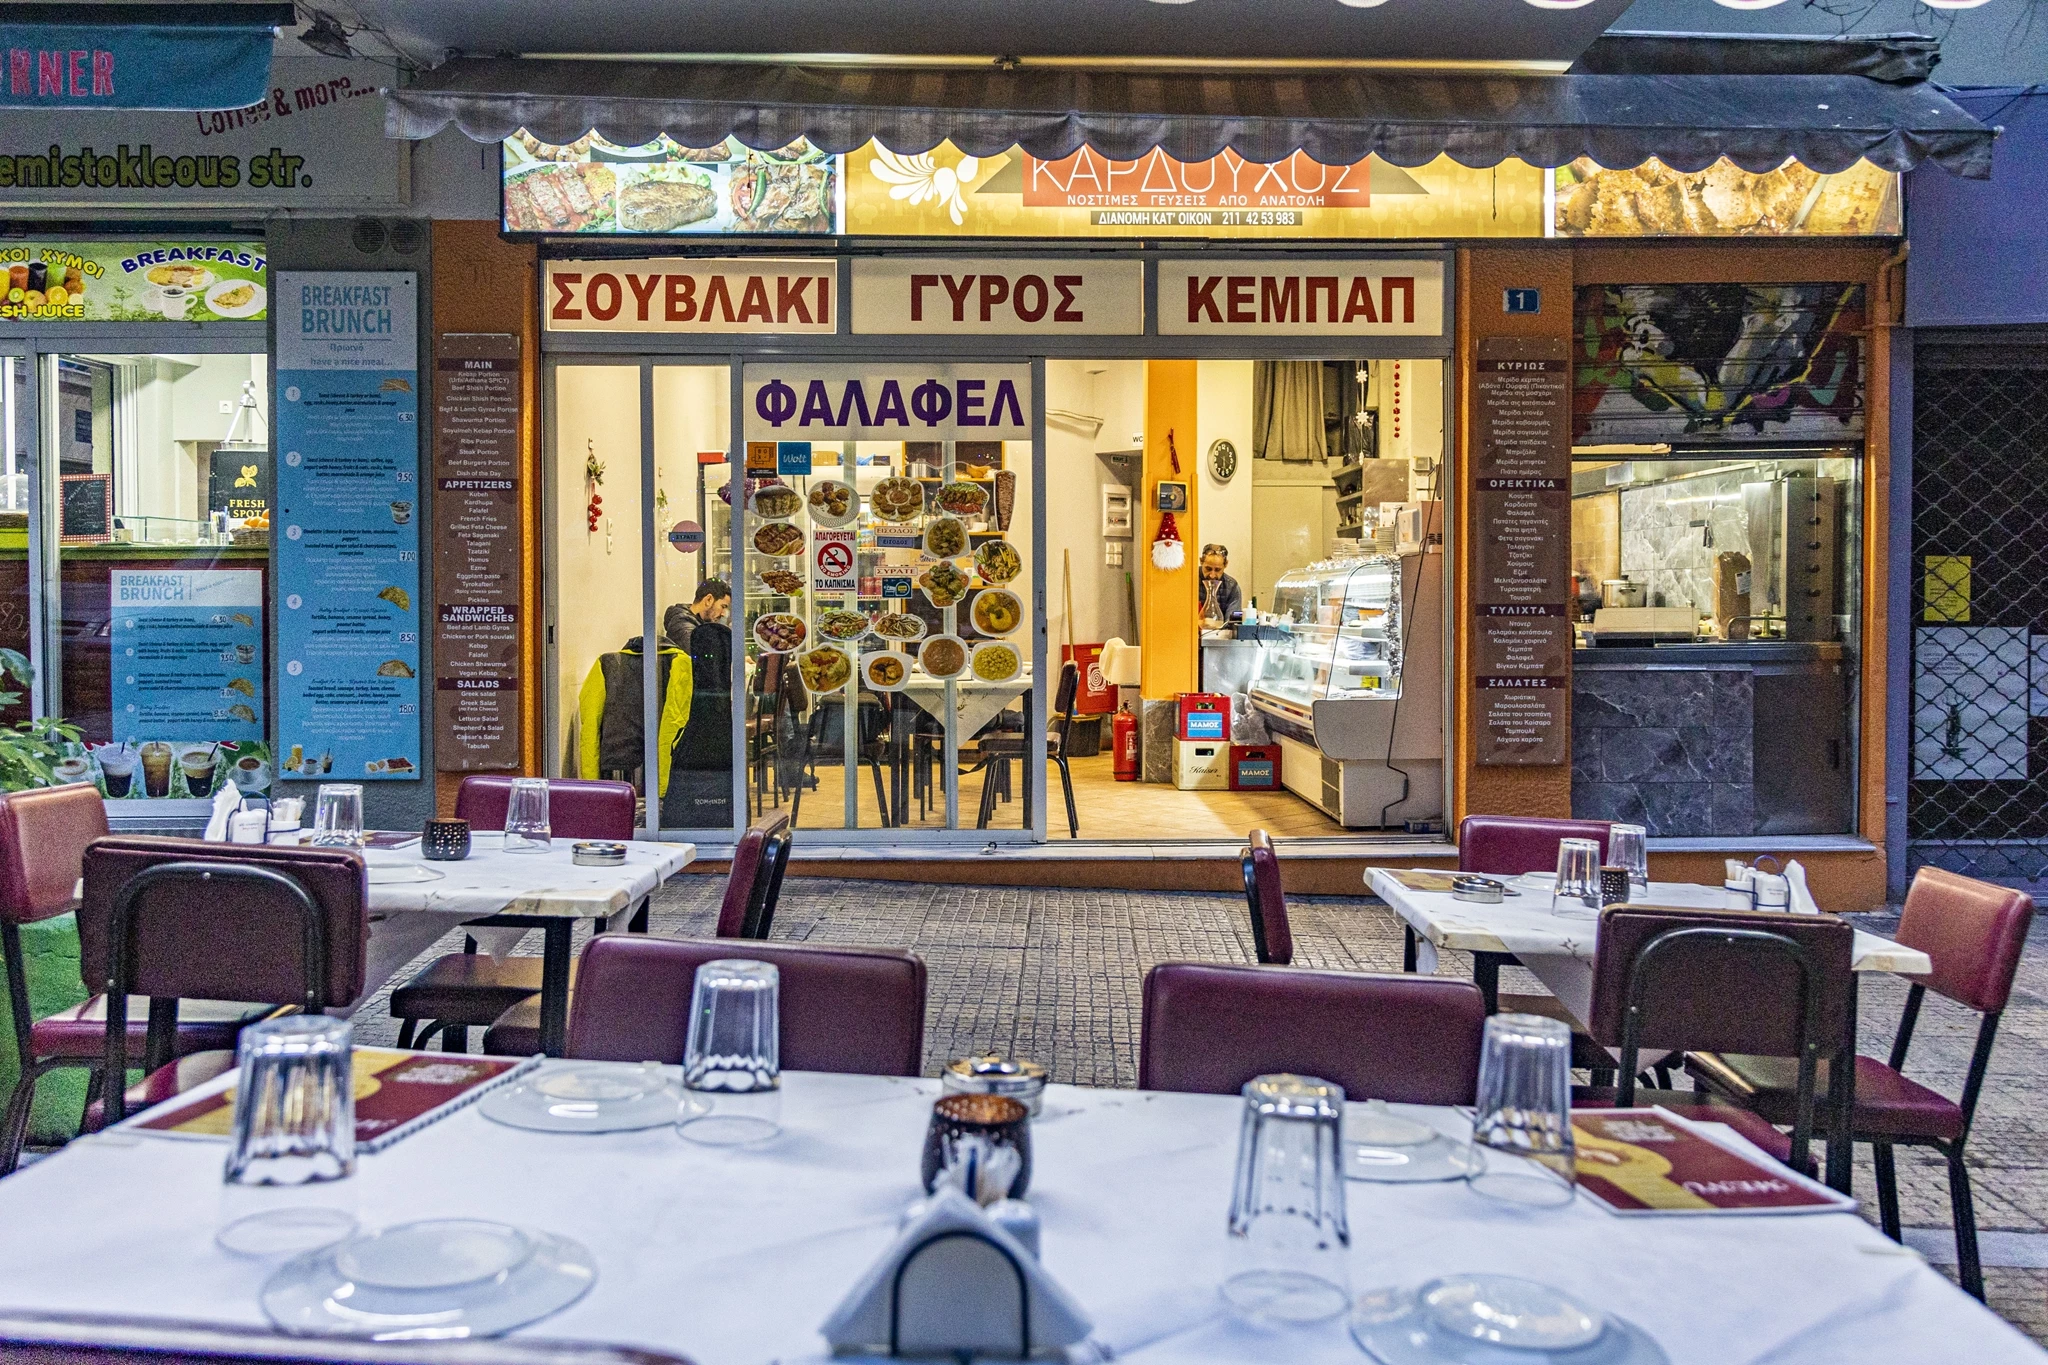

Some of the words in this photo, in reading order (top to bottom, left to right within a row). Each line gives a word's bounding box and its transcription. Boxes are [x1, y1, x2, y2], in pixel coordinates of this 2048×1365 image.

[0, 48, 115, 97] RNER
[272, 87, 292, 116] &
[248, 147, 313, 188] str.
[1067, 194, 1138, 206] ΝΟΣΤΙΜΕΣ
[1150, 194, 1208, 206] ΓΕΥΣΕΙΣ
[1218, 195, 1248, 206] ΑΠΟ
[1259, 195, 1325, 206] ΑΝΑΤΟΛΗ
[1098, 211, 1150, 225] ΔΙΑΝΟΜΗ
[1178, 212, 1212, 225] ΟΙΚΟΝ
[1222, 212, 1240, 225] 211
[1246, 212, 1259, 225] 42
[1261, 212, 1274, 225] 53
[1276, 212, 1295, 225] 983
[41, 248, 105, 280] ΧΥΜΟΙ
[120, 246, 267, 275] BREAKFAST
[302, 286, 392, 306] BREAKFAST
[552, 273, 830, 325] ΣΟΥΒΛΑΚΙ
[910, 274, 1084, 323] ΓΥΡΟΣ
[1186, 275, 1415, 324] ΚΕΜΠΑΠ
[1516, 291, 1526, 310] 1
[33, 304, 85, 318] JUICE
[302, 308, 392, 334] BRUNCH
[755, 379, 1024, 428] ΦΑΛΑΦΕΛ
[782, 454, 807, 464] Wolt
[229, 500, 266, 508] FRESH
[232, 509, 262, 518] SPOT
[815, 532, 856, 540] ΑΠΑΓΟΡΕΥΕΤΑΙ
[120, 576, 184, 586] BREAKFAST
[815, 580, 824, 588] ΤΟ
[825, 580, 856, 588] ΚΑΠΝΙΣΜΑ
[120, 588, 184, 600] BRUNCH
[442, 614, 515, 622] SANDWICHES
[1189, 766, 1218, 774] Kaiser
